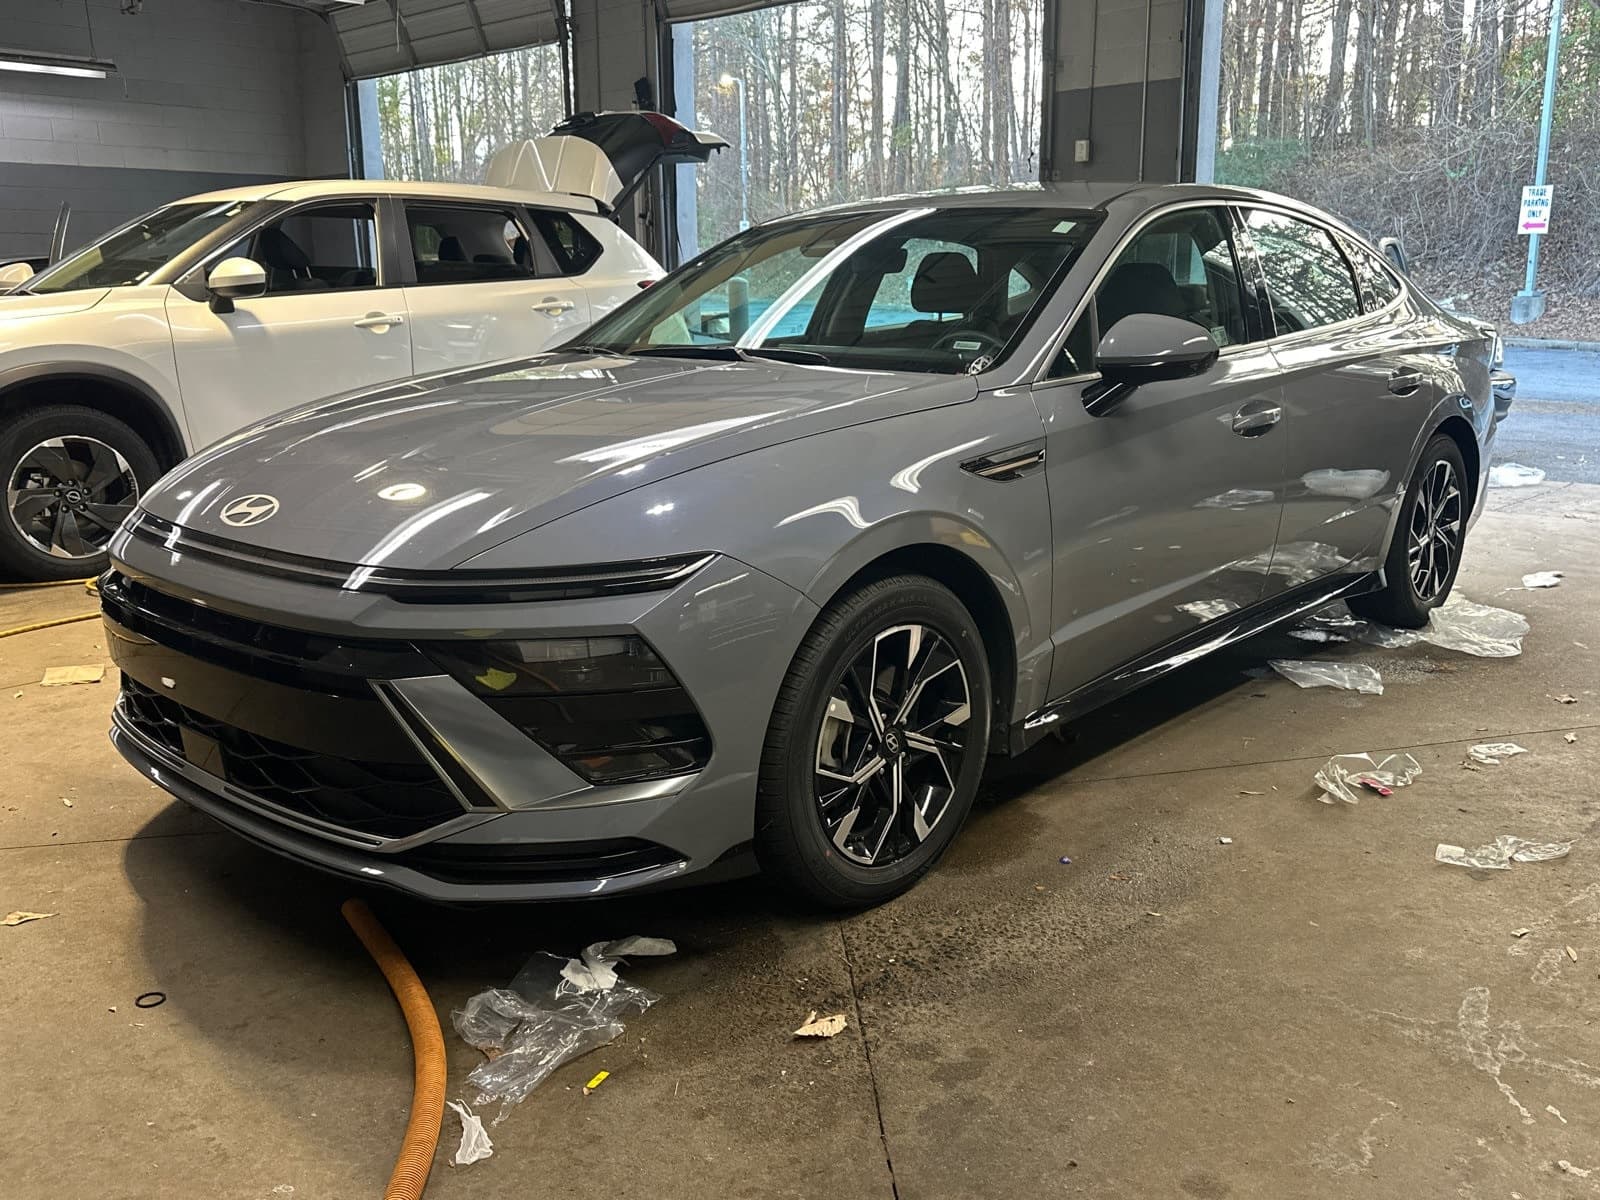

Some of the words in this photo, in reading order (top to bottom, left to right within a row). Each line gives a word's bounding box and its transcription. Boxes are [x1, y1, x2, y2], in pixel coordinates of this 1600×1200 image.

[1528, 188, 1547, 196] TRADE
[1523, 198, 1549, 207] PARKING
[1527, 210, 1542, 218] ONLY
